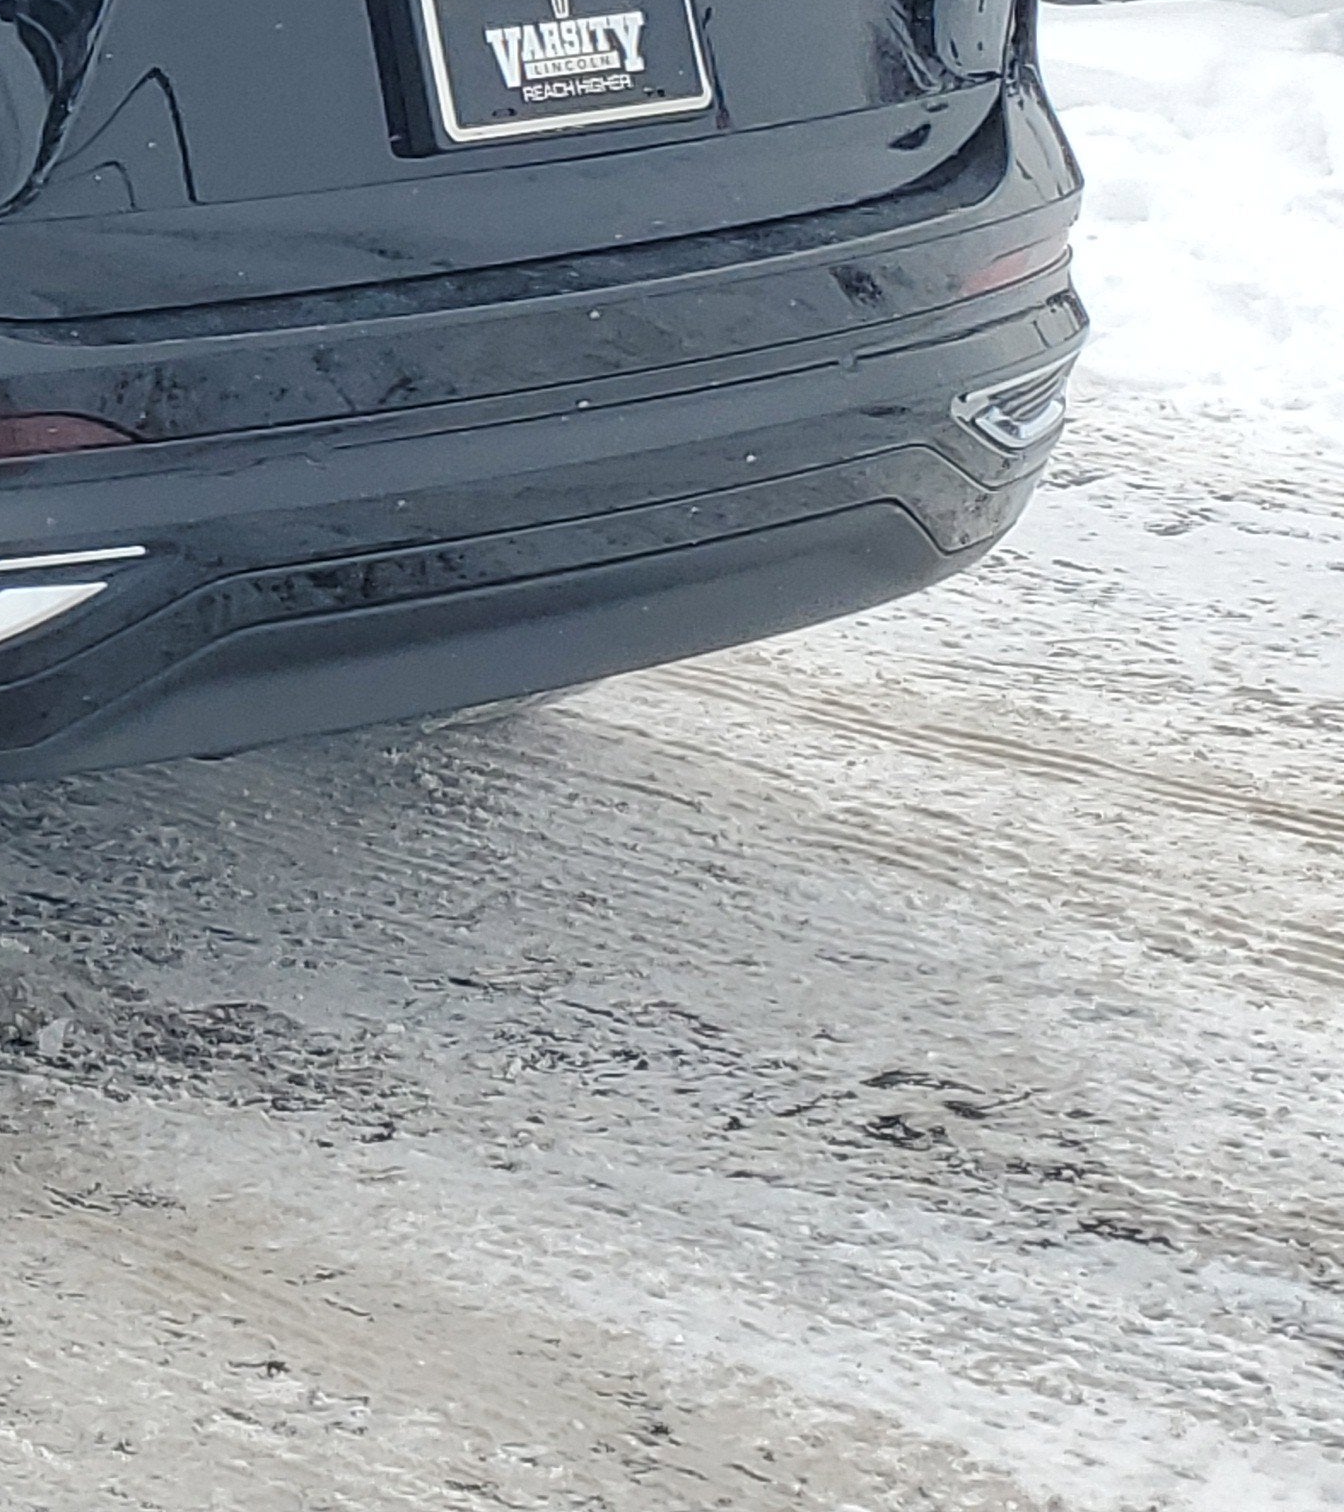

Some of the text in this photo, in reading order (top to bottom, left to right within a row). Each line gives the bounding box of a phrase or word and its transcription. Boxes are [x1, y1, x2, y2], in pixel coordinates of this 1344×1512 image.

[485, 11, 645, 88] VARSITY
[533, 54, 611, 76] LINCOLN
[522, 80, 575, 103] REACH
